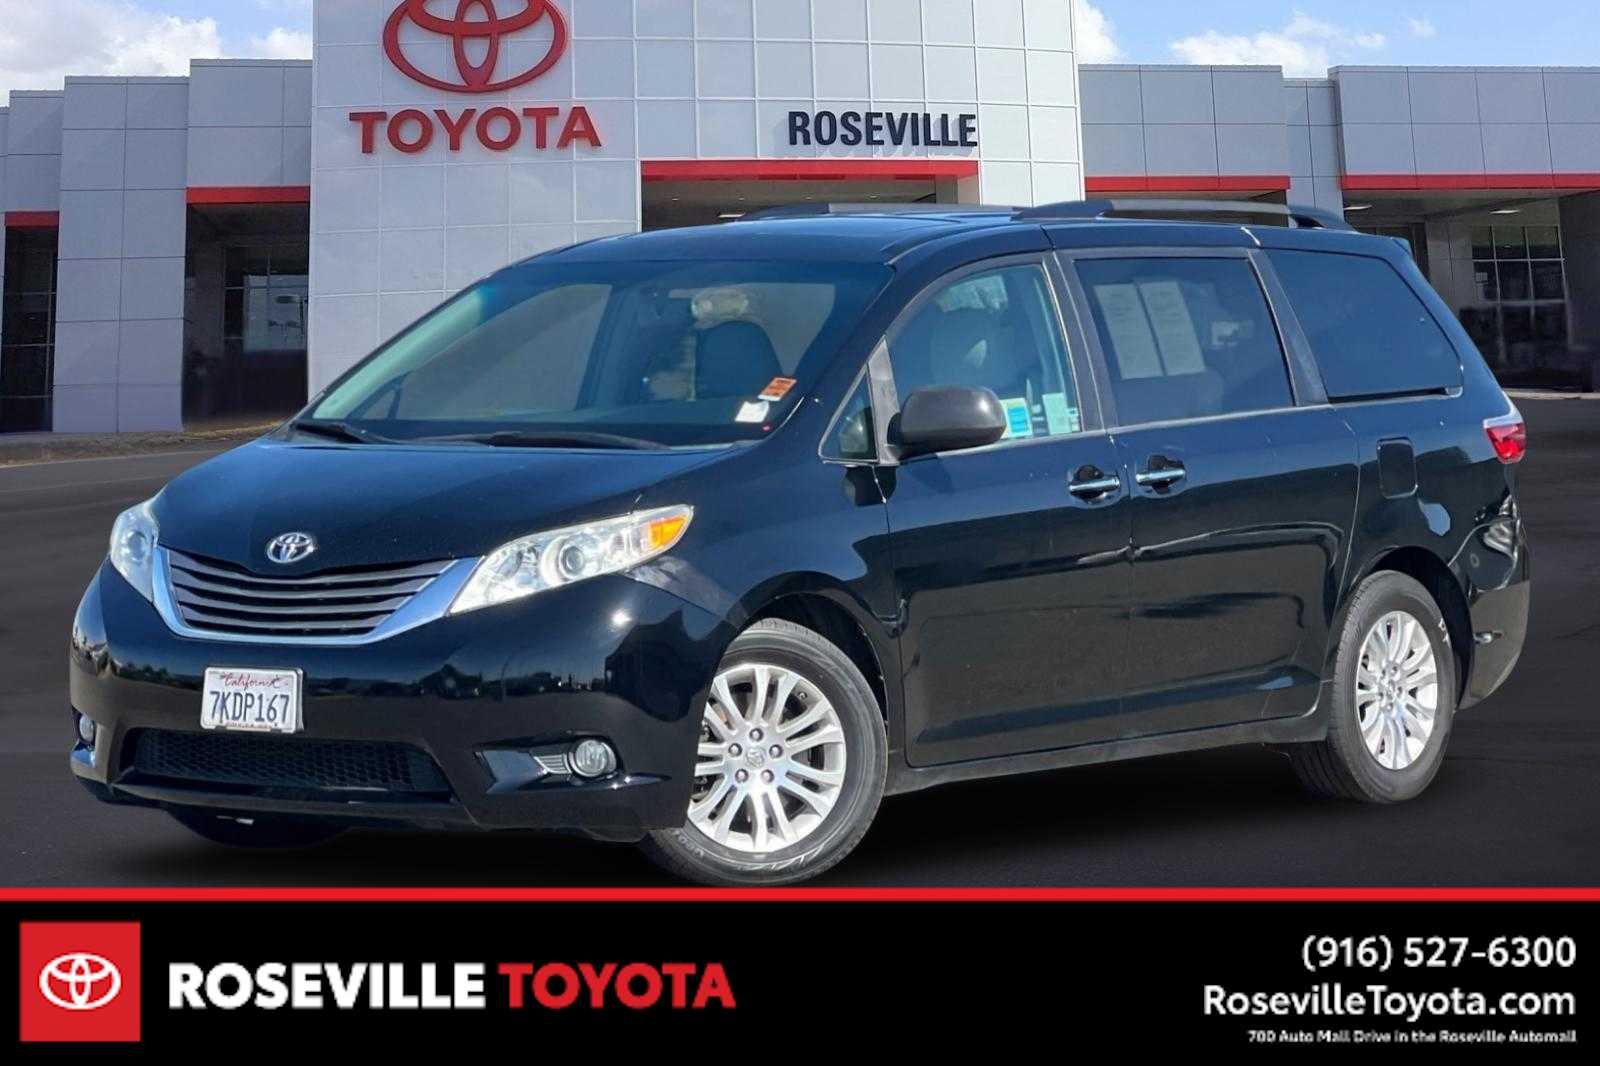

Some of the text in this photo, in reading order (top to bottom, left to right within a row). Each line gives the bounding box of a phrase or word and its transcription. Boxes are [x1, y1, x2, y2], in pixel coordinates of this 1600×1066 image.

[350, 106, 602, 154] TOYOTA
[788, 111, 978, 147] ROSEVILLE
[209, 691, 290, 724] 7KDP167
